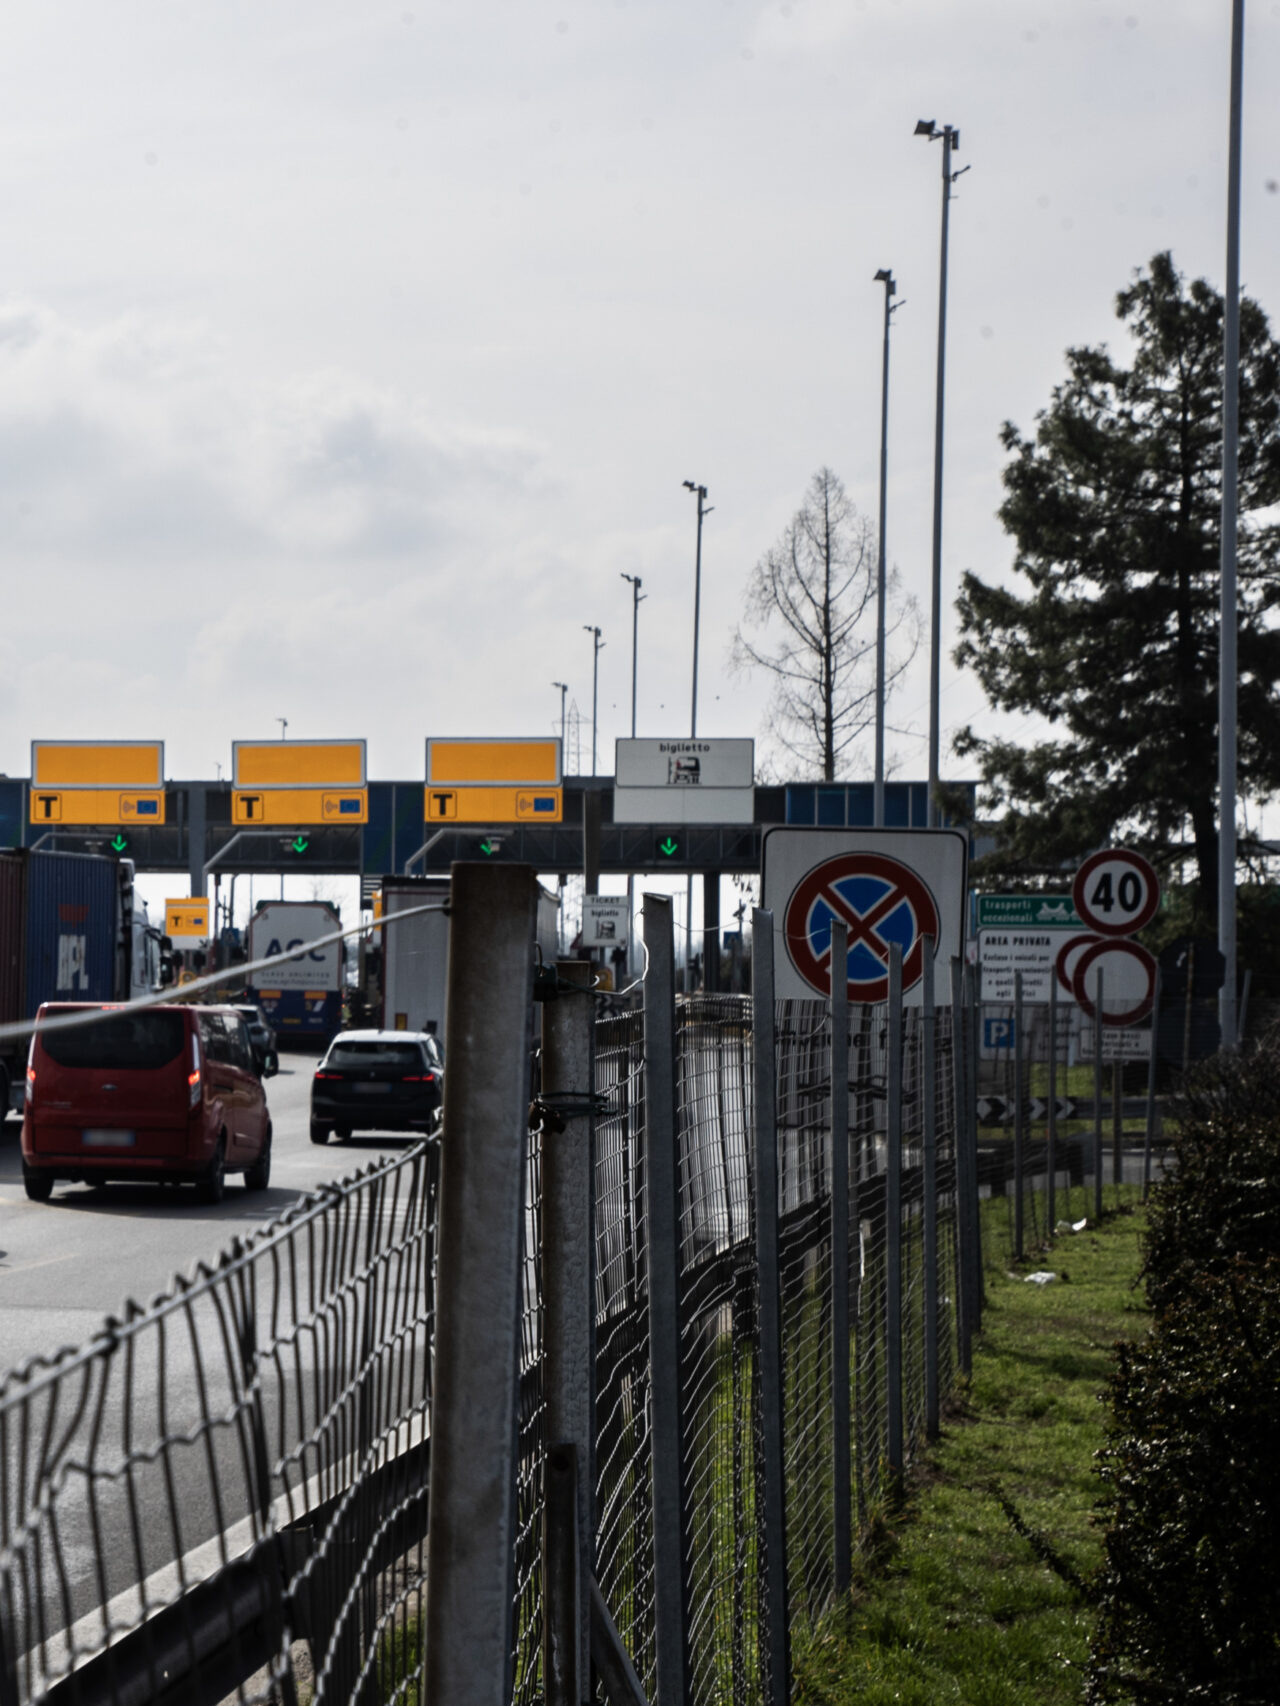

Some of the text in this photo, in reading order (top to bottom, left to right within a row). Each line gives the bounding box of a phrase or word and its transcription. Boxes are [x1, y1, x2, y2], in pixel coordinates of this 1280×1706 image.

[659, 743, 710, 754] biglietto
[38, 796, 58, 818] T
[239, 796, 259, 819] T
[433, 793, 453, 816] T
[1091, 871, 1142, 913] 40
[985, 900, 1031, 911] trasporti
[591, 910, 619, 918] biglietto
[982, 913, 1033, 923] eccezionali
[171, 915, 182, 927] T
[985, 936, 1051, 946] AREA PRIVATA
[990, 1021, 1008, 1045] P
